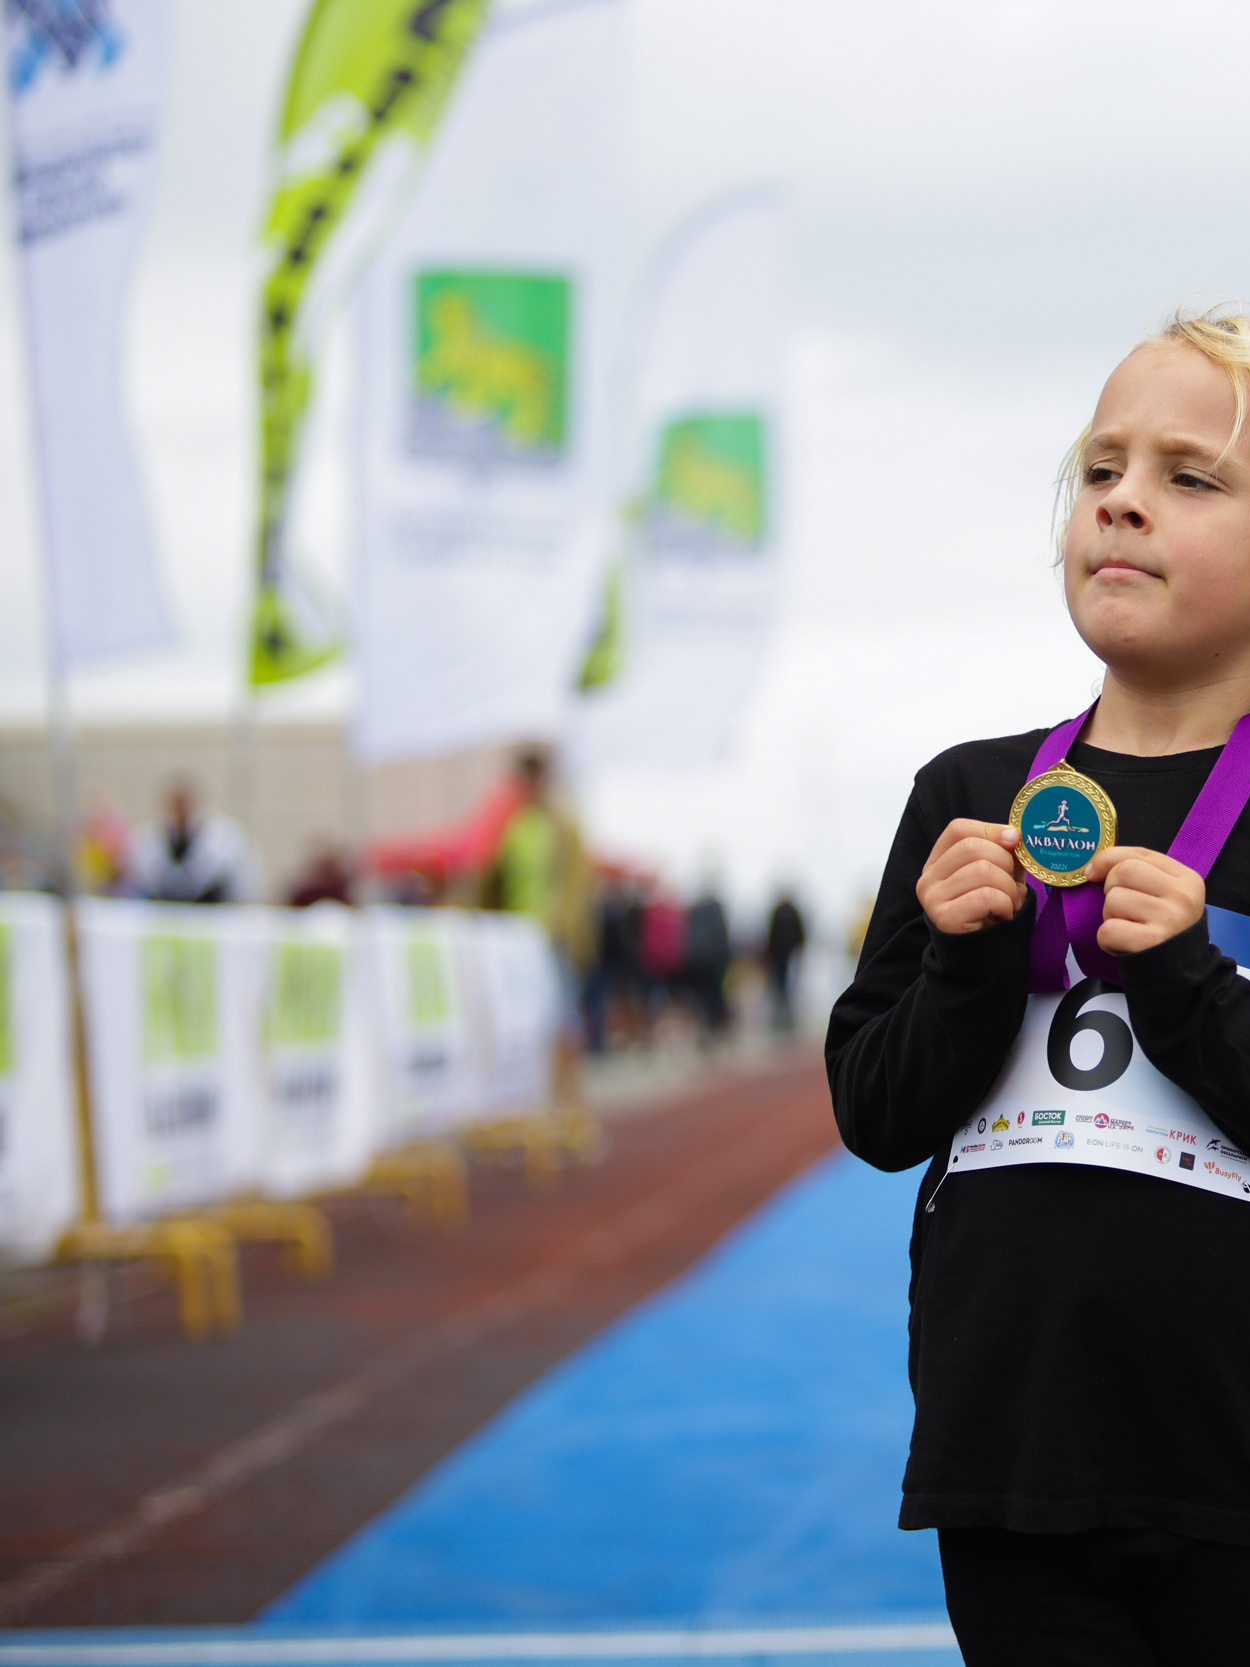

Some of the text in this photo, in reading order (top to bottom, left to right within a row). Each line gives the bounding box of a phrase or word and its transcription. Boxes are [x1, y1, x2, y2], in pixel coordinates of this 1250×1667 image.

[1026, 834, 1096, 851] АКВАТЛОН
[1040, 848, 1080, 858] Владивосток
[1047, 976, 1133, 1091] 6
[1008, 1137, 1043, 1146] PANDOROOM
[1169, 1129, 1197, 1146] КРИК
[1105, 1140, 1122, 1150] LIFE
[1122, 1143, 1130, 1151] IS
[1131, 1145, 1144, 1153] ON
[1214, 1167, 1243, 1183] BusyFly
